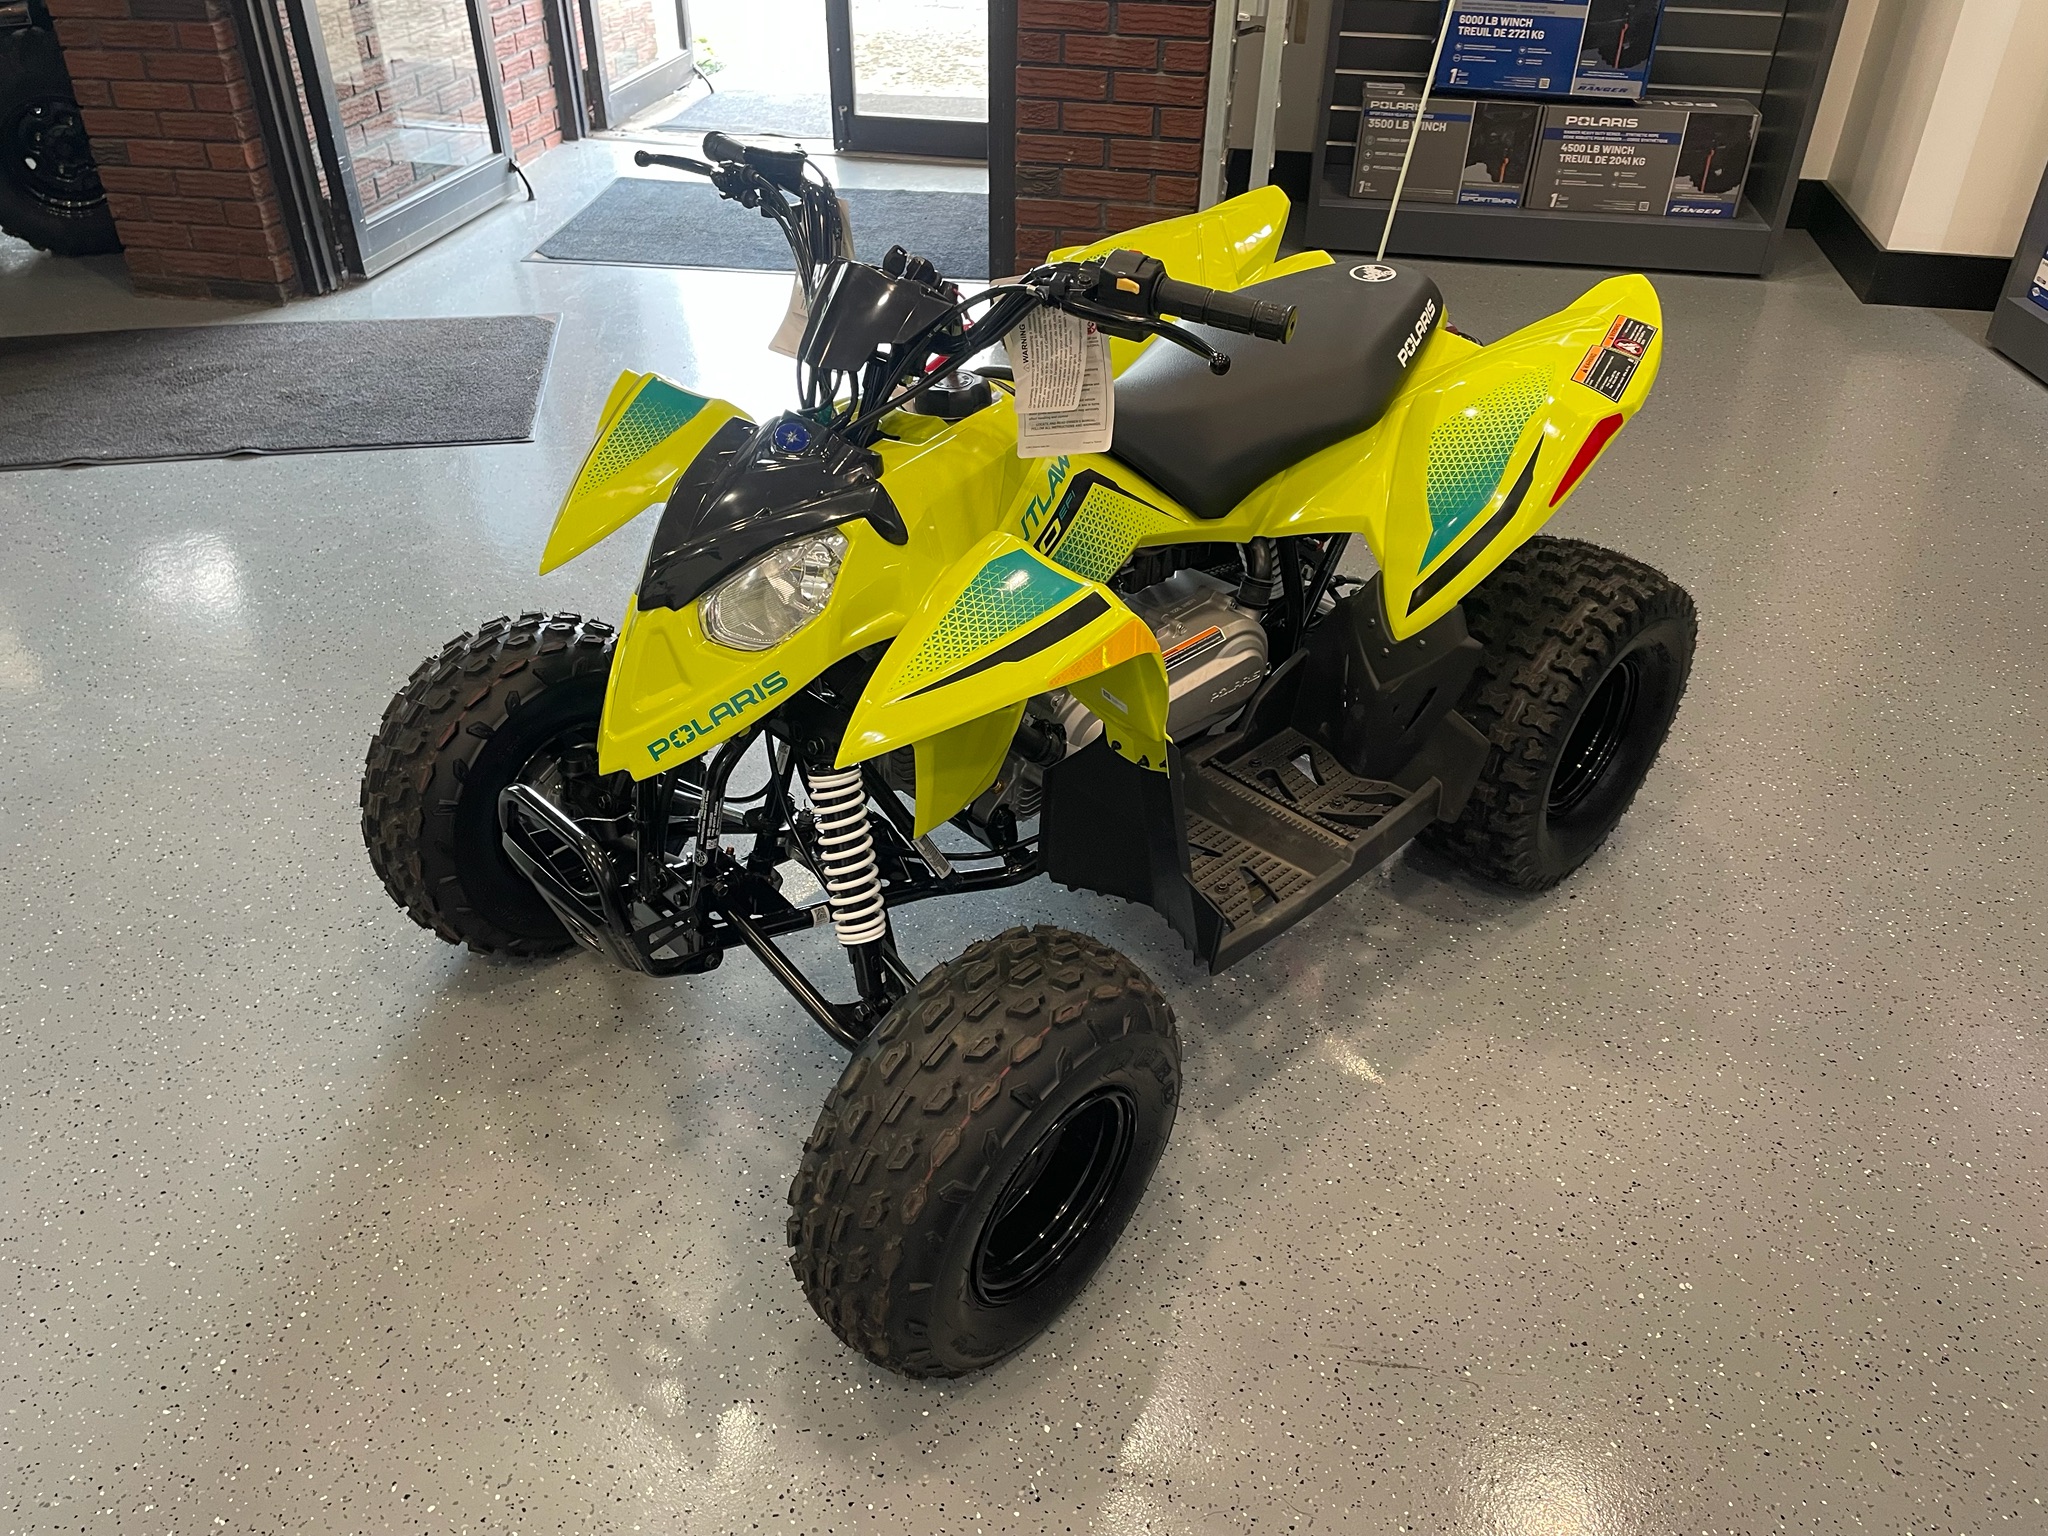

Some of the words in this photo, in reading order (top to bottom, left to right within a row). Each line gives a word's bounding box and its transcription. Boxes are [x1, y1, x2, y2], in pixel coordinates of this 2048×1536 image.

[1459, 15, 1484, 25] 6000
[1485, 16, 1499, 26] LB
[1500, 17, 1534, 28] WINCH
[1458, 26, 1492, 37] TREUIL
[1493, 28, 1506, 38] DE
[1508, 29, 1530, 39] 2721
[1530, 30, 1545, 40] KG
[1577, 85, 1629, 93] RANGER
[1368, 119, 1394, 129] 3500
[1395, 120, 1410, 130] LB
[1565, 116, 1639, 128] POLARIS
[1560, 143, 1586, 153] 4500
[1586, 144, 1600, 154] LB
[1602, 145, 1635, 155] WINCH
[1559, 153, 1593, 164] TREUIL
[1594, 155, 1608, 165] DE
[1609, 156, 1631, 166] 2041
[1632, 157, 1646, 166] KG
[1671, 207, 1722, 215] RANGER
[1397, 298, 1436, 368] POLARIS
[1019, 324, 1029, 364] WARNING
[1058, 490, 1076, 520] EFI
[647, 670, 789, 762] POLARIS
